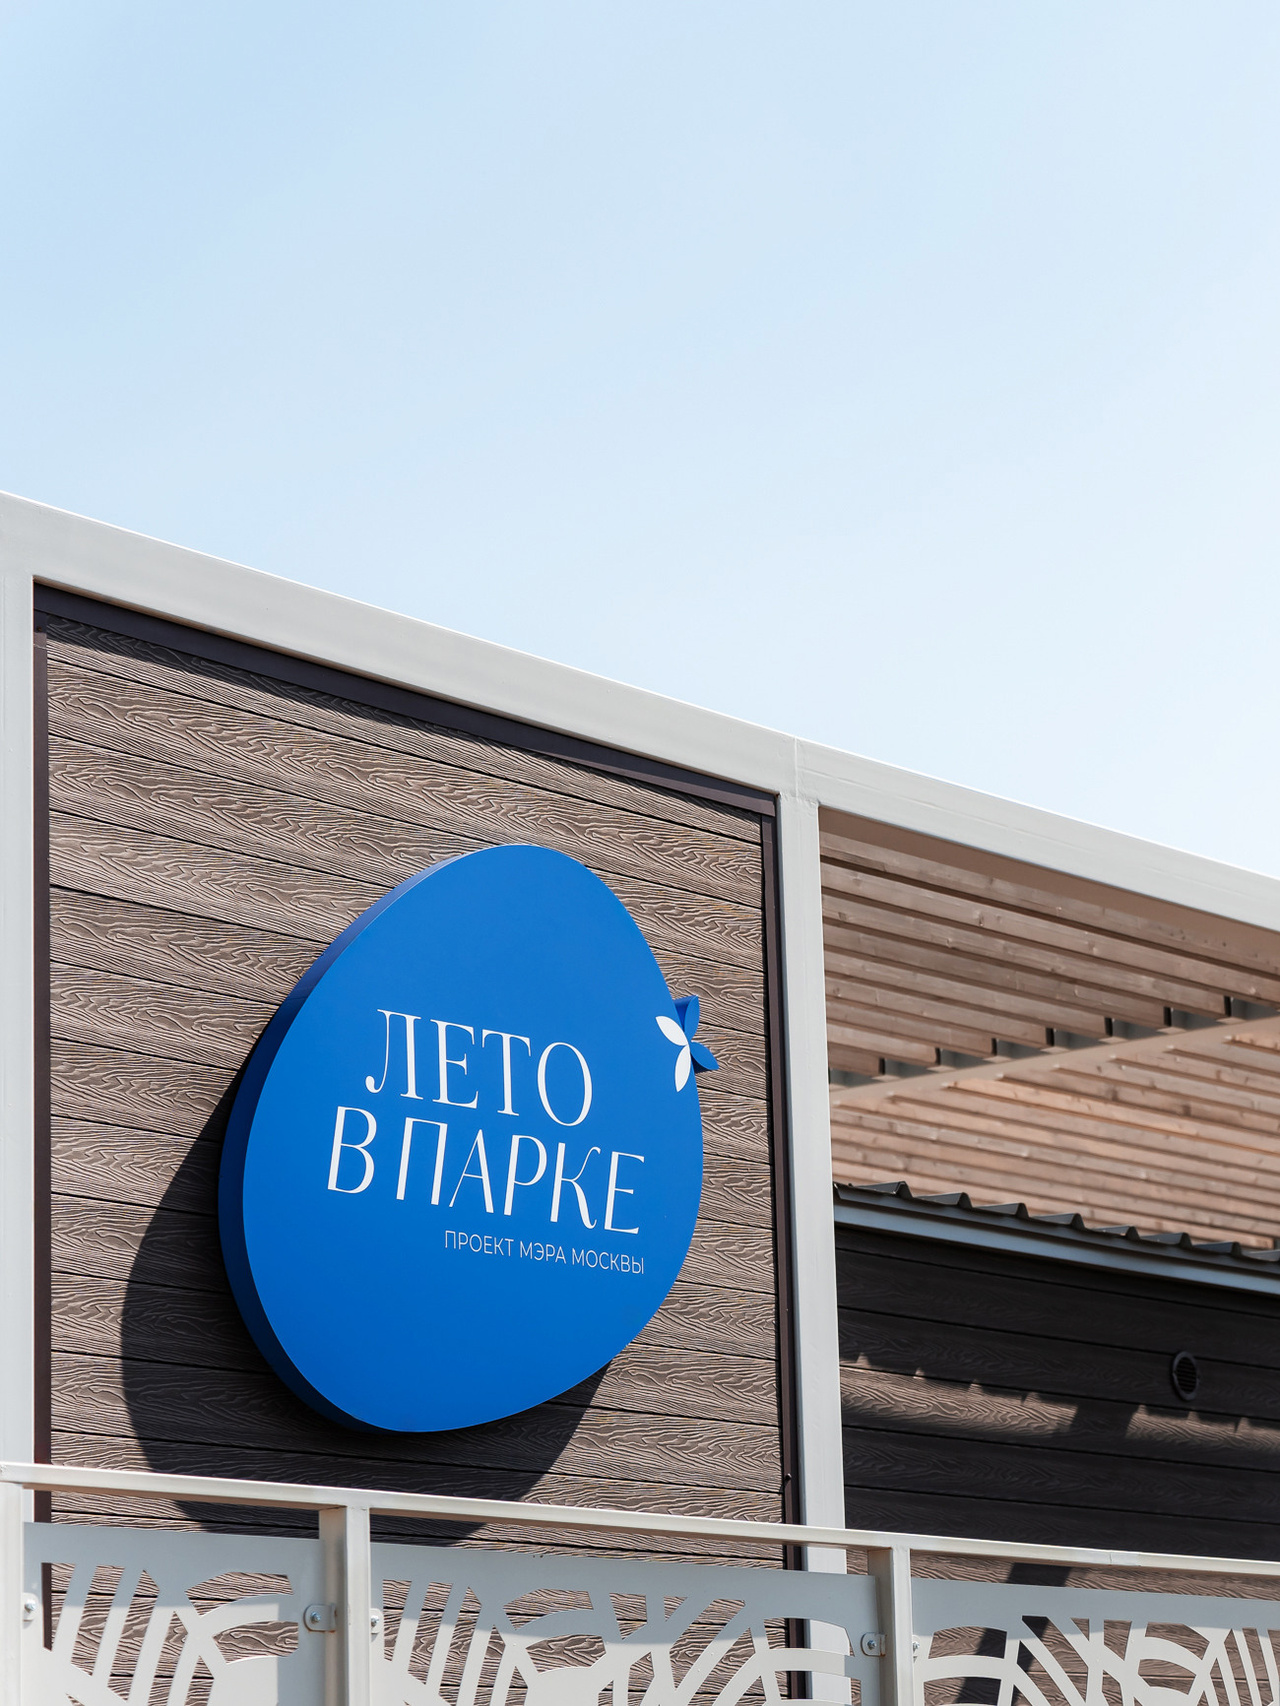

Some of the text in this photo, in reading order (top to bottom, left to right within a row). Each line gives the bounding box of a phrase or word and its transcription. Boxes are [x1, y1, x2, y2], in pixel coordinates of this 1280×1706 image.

[364, 1008, 594, 1127] ЛЕТО
[327, 1105, 646, 1235] В ПАРКЕ
[444, 1230, 645, 1275] ПРОЕКТ МЭРА МОСКВЫ
